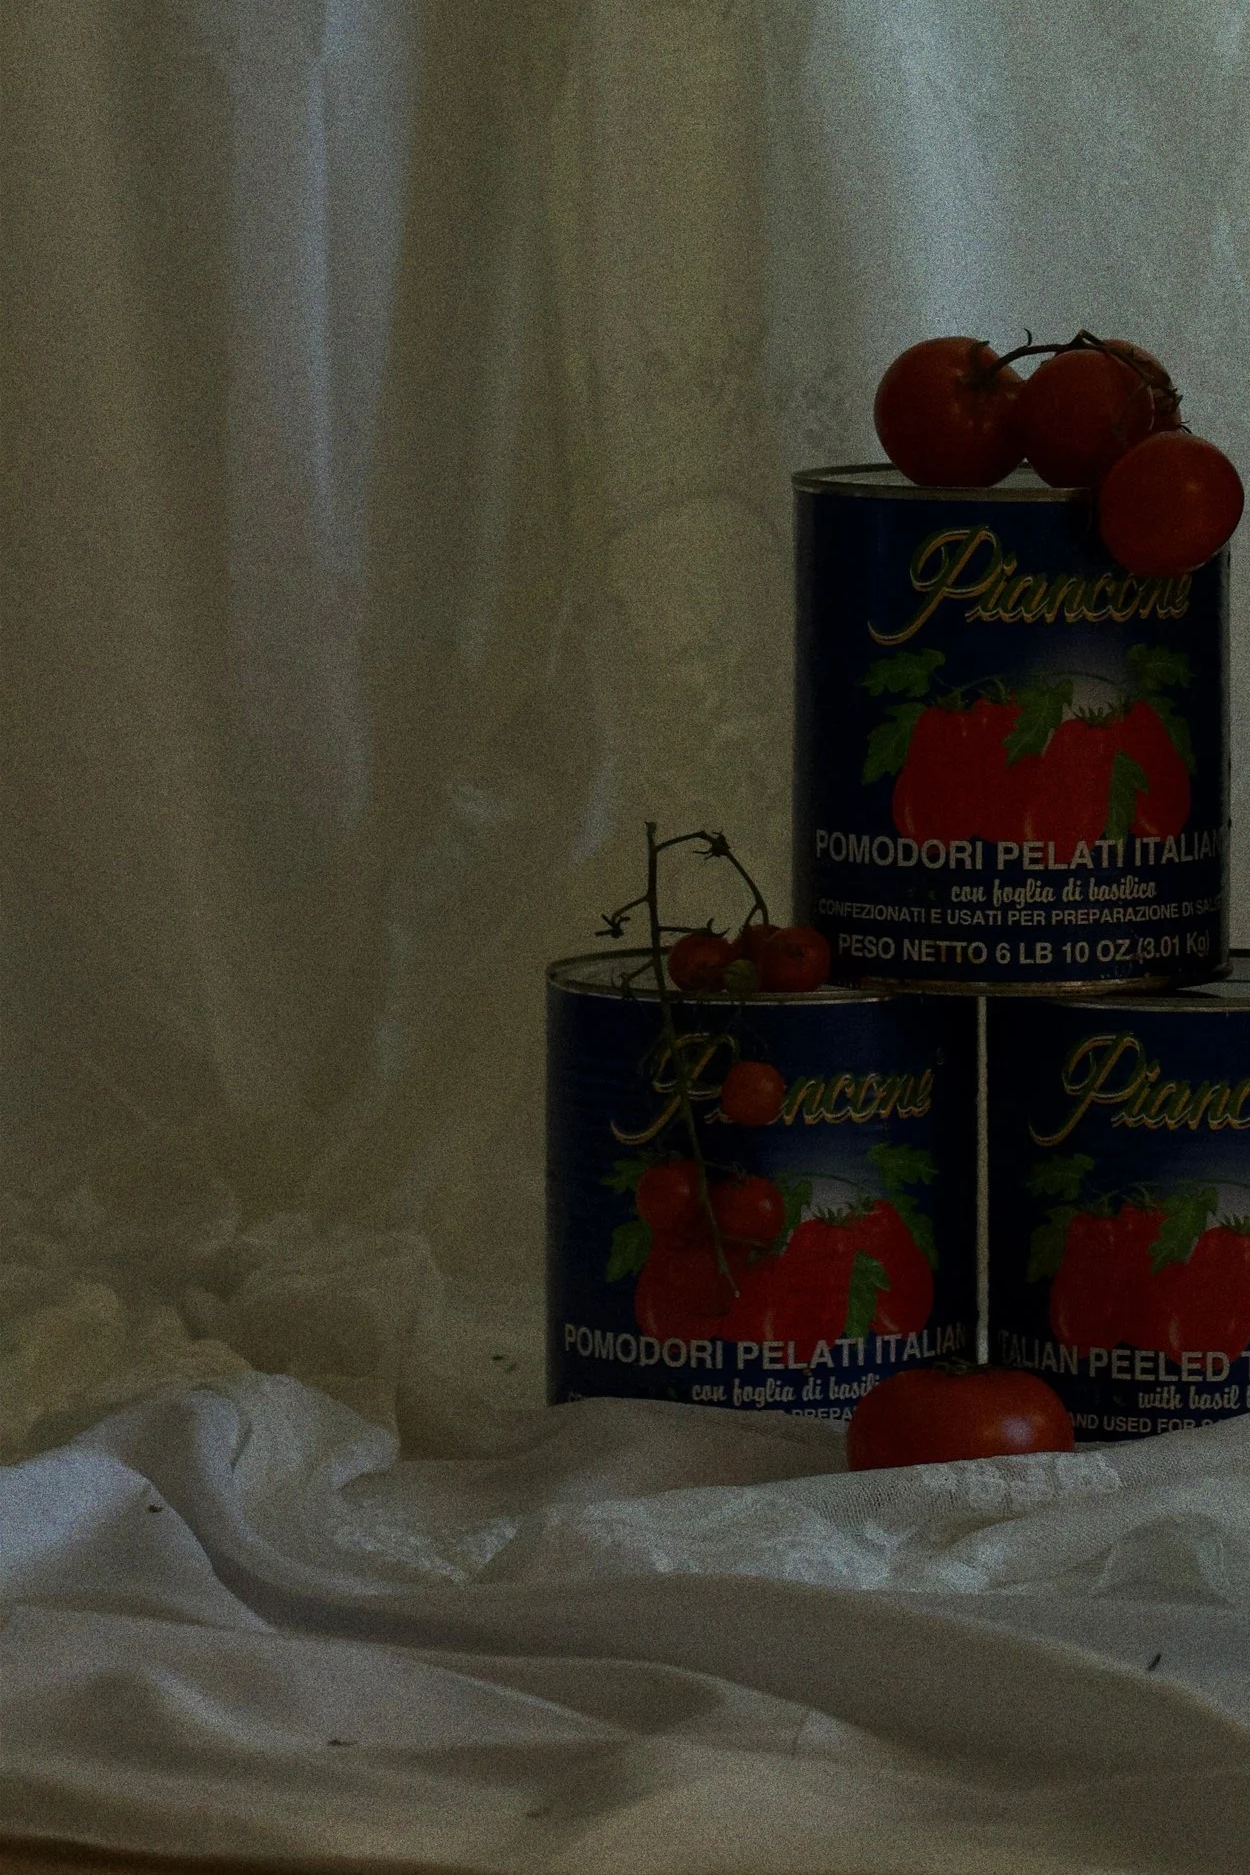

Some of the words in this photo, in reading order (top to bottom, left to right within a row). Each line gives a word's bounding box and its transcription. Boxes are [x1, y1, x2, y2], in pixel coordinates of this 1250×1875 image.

[867, 524, 1193, 646] Piancone
[815, 829, 983, 870] POMODORI
[996, 839, 1125, 870] PELATI
[1133, 829, 1222, 867] ITALIAN
[950, 885, 987, 903] con
[992, 878, 1056, 909] foglia
[1062, 877, 1083, 903] di
[1088, 875, 1159, 902] basilico
[818, 898, 926, 924] CONFEZIONATI
[930, 908, 942, 924] E
[946, 909, 1002, 926] USATI
[1008, 910, 1046, 926] PER
[1052, 902, 1180, 926] PREPARAZIONE
[1182, 901, 1195, 918] DI
[837, 933, 896, 960] PESO
[903, 938, 988, 965] NETTO
[995, 941, 1012, 965] 6
[1018, 942, 1053, 965] LB
[1062, 941, 1090, 964] 10
[1096, 938, 1132, 962] OZ
[1135, 934, 1181, 964] (3.01
[1185, 928, 1210, 958] Kg)
[610, 1032, 937, 1146] Pncone
[564, 1324, 725, 1370] POMODORI
[736, 1335, 865, 1371] PELATI
[875, 1321, 966, 1364] ITALIAN
[996, 1329, 1079, 1376] TALIAN
[1088, 1346, 1231, 1383] PEELED
[692, 1384, 727, 1402] con
[731, 1377, 796, 1407] foglia
[801, 1376, 824, 1401] di
[1138, 1384, 1184, 1410] with
[1188, 1384, 1241, 1410] basil
[1103, 1414, 1152, 1434] USED
